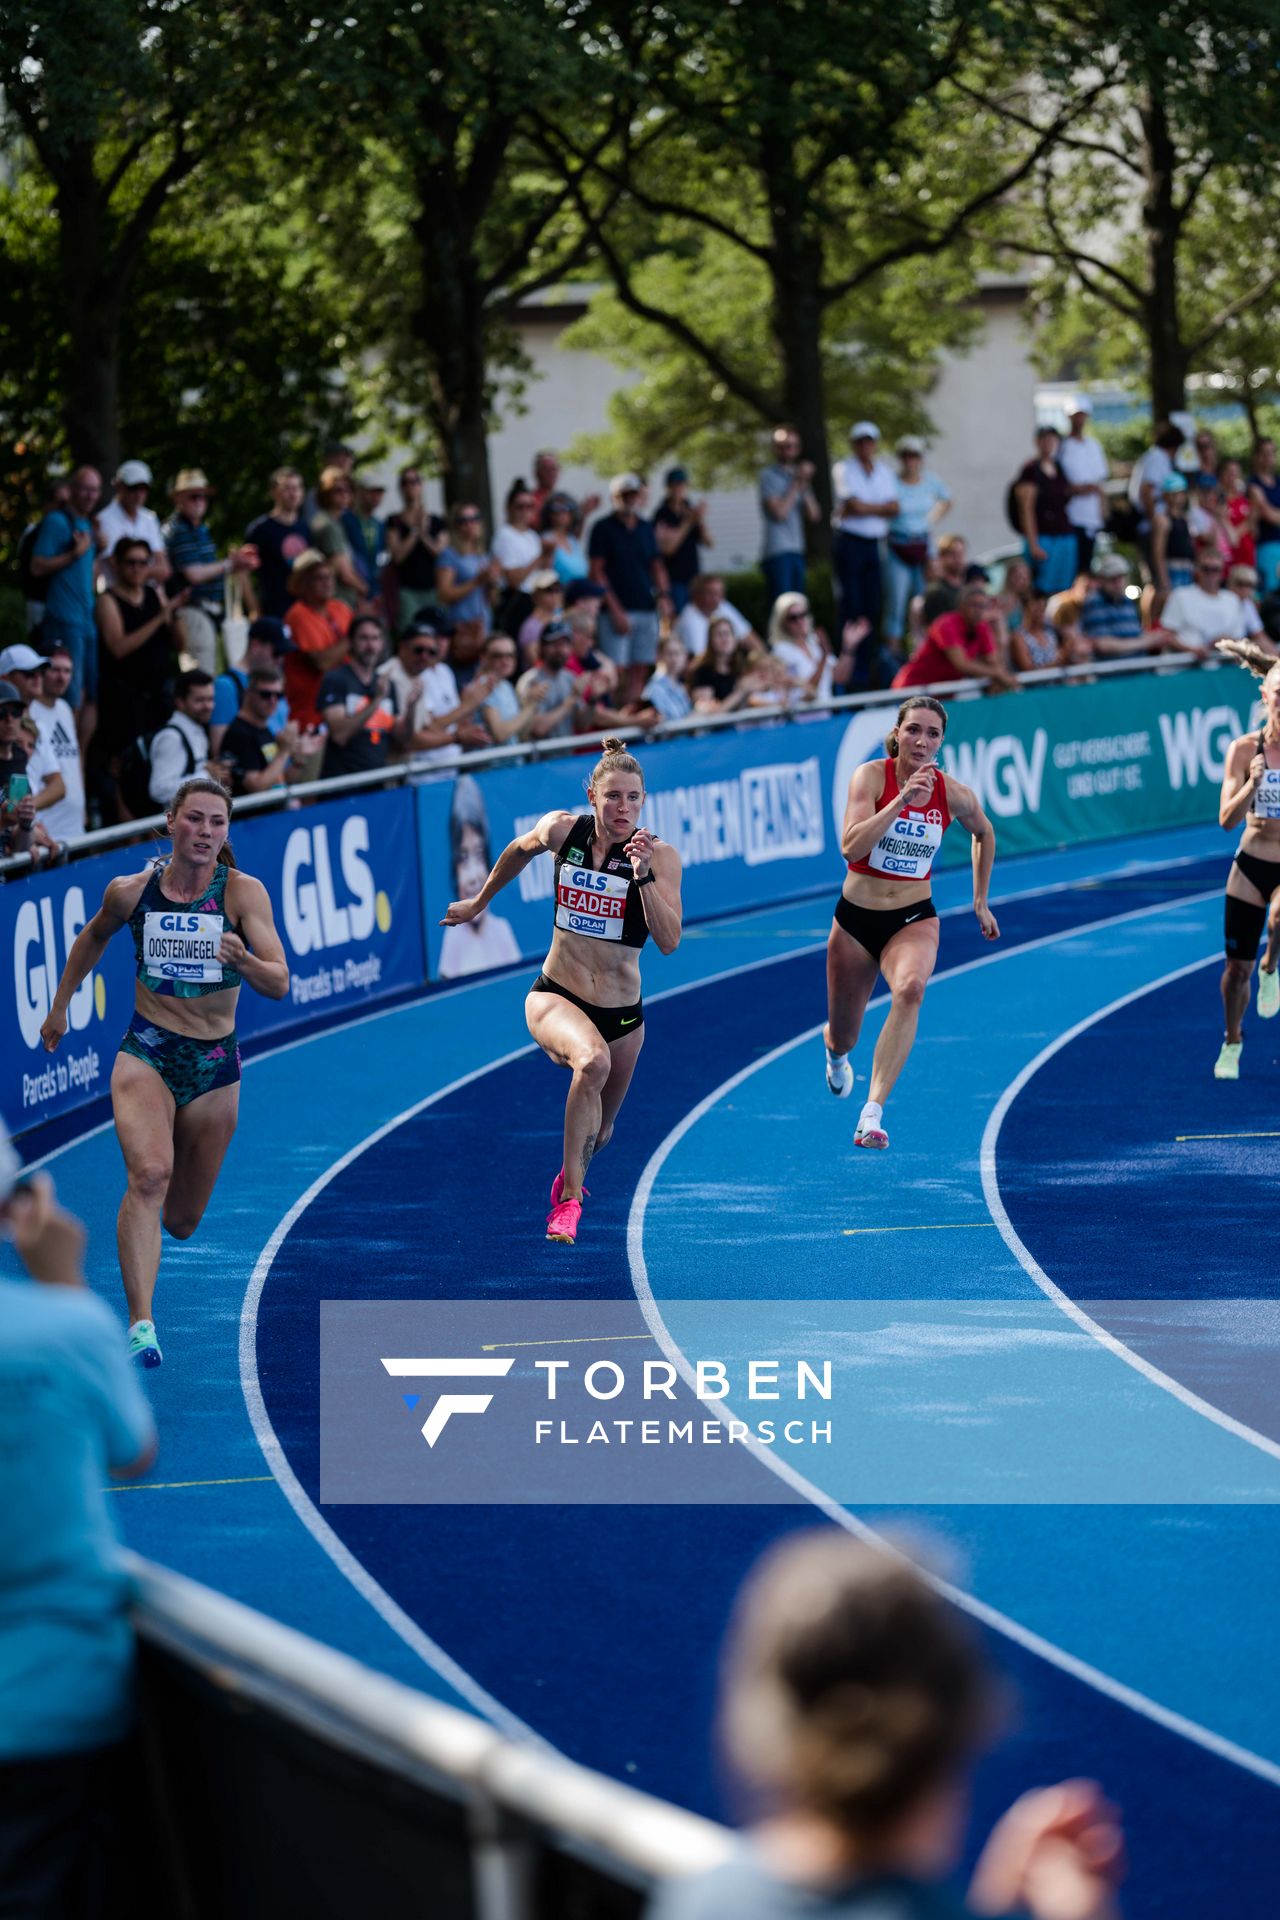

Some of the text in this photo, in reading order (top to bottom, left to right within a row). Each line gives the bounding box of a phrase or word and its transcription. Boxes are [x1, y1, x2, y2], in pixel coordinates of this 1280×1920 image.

[943, 728, 1048, 817] WGV
[1257, 788, 1280, 804] ESS
[560, 888, 622, 917] LEADER
[582, 918, 605, 930] PLAN
[149, 937, 216, 960] OOSTERWEGEL
[23, 1045, 99, 1109] Parcels to People
